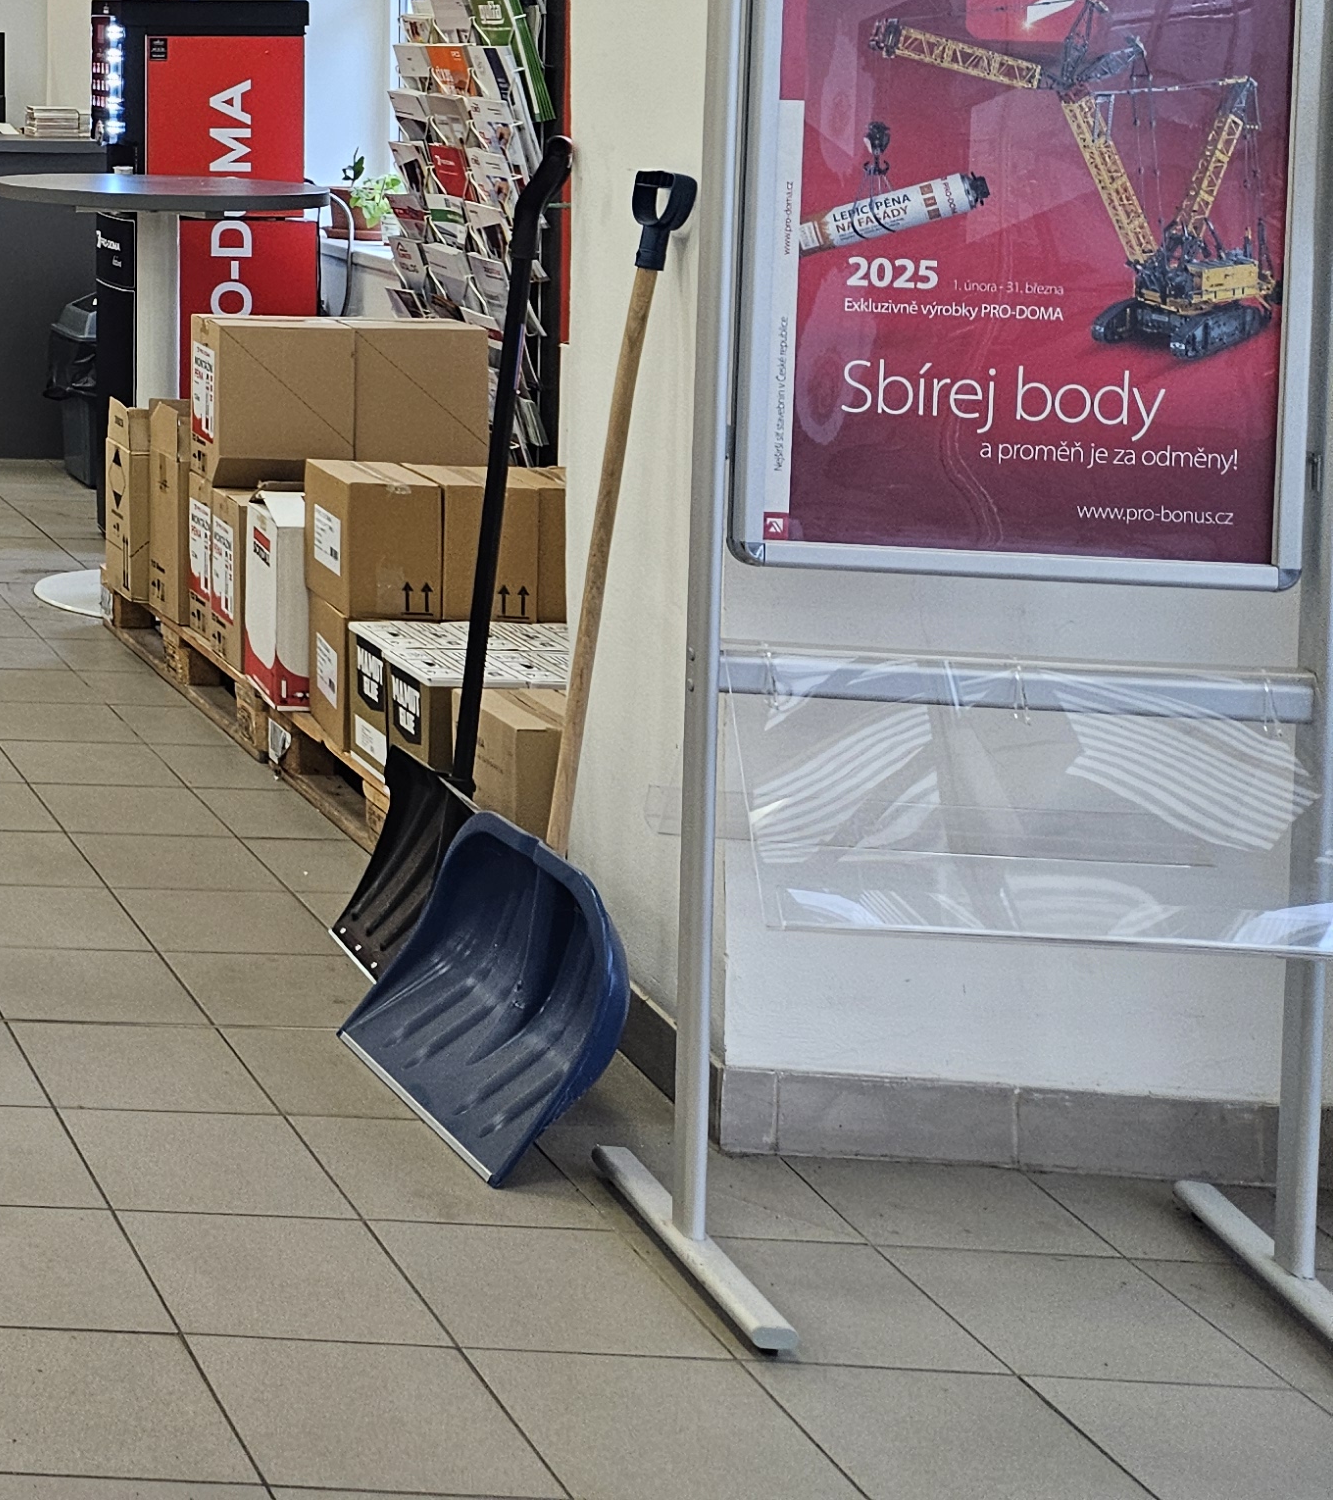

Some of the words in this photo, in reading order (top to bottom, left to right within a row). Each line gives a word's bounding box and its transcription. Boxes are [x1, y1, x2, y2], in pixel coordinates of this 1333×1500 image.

[784, 180, 794, 255] www.pro-doma.cz
[875, 193, 912, 212] PĚNA
[846, 256, 939, 290] 2025
[953, 279, 962, 291] 1.
[964, 280, 997, 293] února
[1006, 281, 1023, 294] 31.
[844, 297, 919, 315] Exkluzivně
[921, 301, 978, 321] výrobky
[981, 303, 1064, 322] PRO-DOMA
[841, 359, 998, 435] Sbírej
[1015, 366, 1167, 441] body
[979, 444, 992, 460] a
[997, 441, 1083, 471] proměň
[1087, 446, 1109, 469] je
[1113, 450, 1136, 467] za
[1141, 445, 1240, 473] odměny!
[1076, 502, 1235, 527] www.pro-bonus.cz
[356, 643, 384, 687] MAMUT
[391, 673, 421, 718] MAMUT
